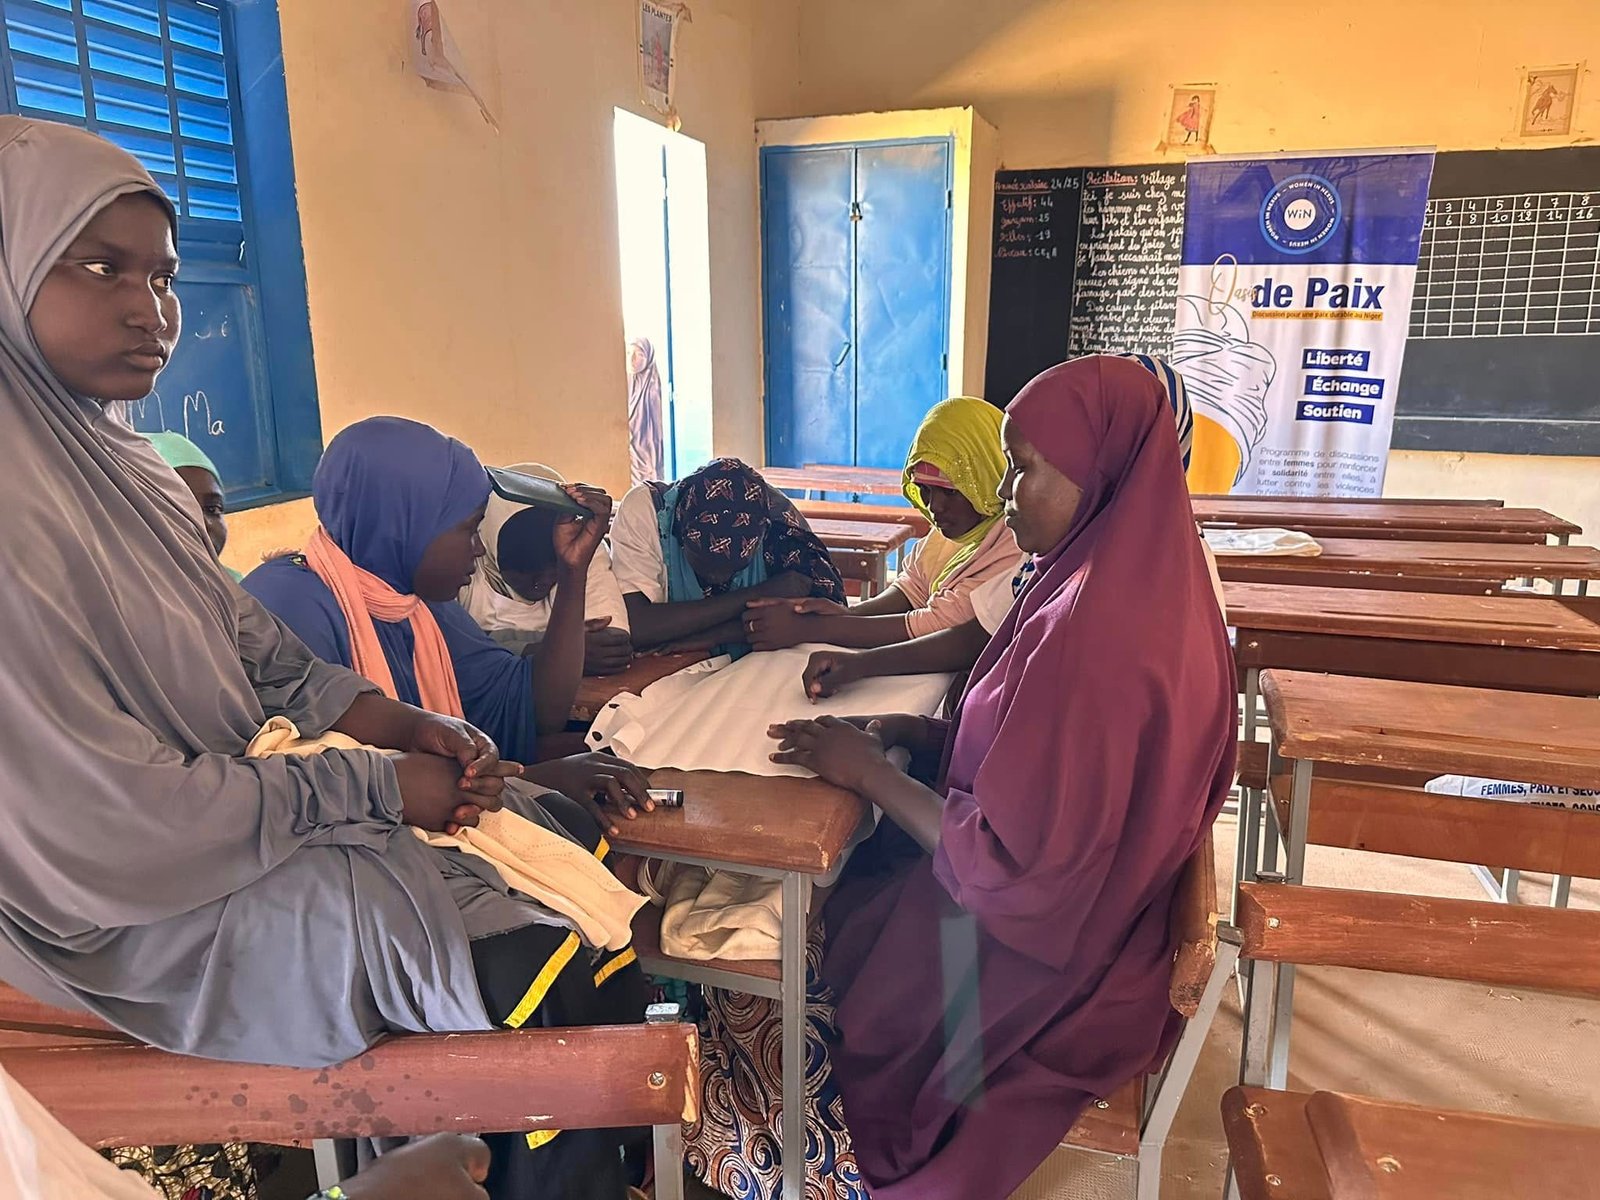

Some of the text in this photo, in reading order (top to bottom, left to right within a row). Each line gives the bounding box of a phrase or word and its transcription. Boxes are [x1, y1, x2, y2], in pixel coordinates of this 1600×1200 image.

[642, 3, 672, 23] LES PLANTES
[1050, 176, 1079, 190] 24/25
[1086, 170, 1138, 187] Récitation:
[1288, 181, 1313, 190] WOMEN
[1313, 182, 1321, 190] IN
[1103, 188, 1114, 205] je
[1118, 188, 1141, 200] suis
[1144, 186, 1167, 205] chez
[1135, 203, 1153, 218] que
[1425, 195, 1590, 213] 2 3 4 5 6 7 8
[1038, 213, 1050, 223] 25
[1119, 214, 1130, 226] et
[1287, 208, 1312, 219] WiN
[1445, 214, 1453, 226] 6
[1469, 213, 1478, 225] 8
[1489, 212, 1509, 223] 10
[1517, 210, 1532, 222] 12
[1545, 210, 1563, 221] 14
[1575, 207, 1594, 219] 16
[1035, 229, 1051, 241] 19
[1317, 217, 1335, 240] WOMEN
[1107, 263, 1138, 276] chiens
[1107, 278, 1119, 287] en
[1120, 275, 1149, 290] signe
[1151, 275, 1165, 286] de
[1251, 277, 1294, 309] de
[1305, 277, 1386, 309] Paix
[1133, 299, 1146, 311] de
[1252, 310, 1382, 322] Discussion pour une paix durable au Niger
[1306, 350, 1364, 366] Liberté
[1312, 376, 1380, 396] Échange
[183, 390, 225, 440] Ma
[1303, 404, 1362, 419] Soutien
[1259, 446, 1380, 462] Programme de discussions
[1257, 467, 1266, 475] la
[1272, 469, 1308, 478] solidarité
[1313, 471, 1336, 479] entre
[1258, 458, 1378, 473] entre femmes pour renforcer
[1256, 478, 1375, 494] lutter contre les violences
[1480, 783, 1527, 797] FEMMES,
[1529, 784, 1555, 794] PAIX
